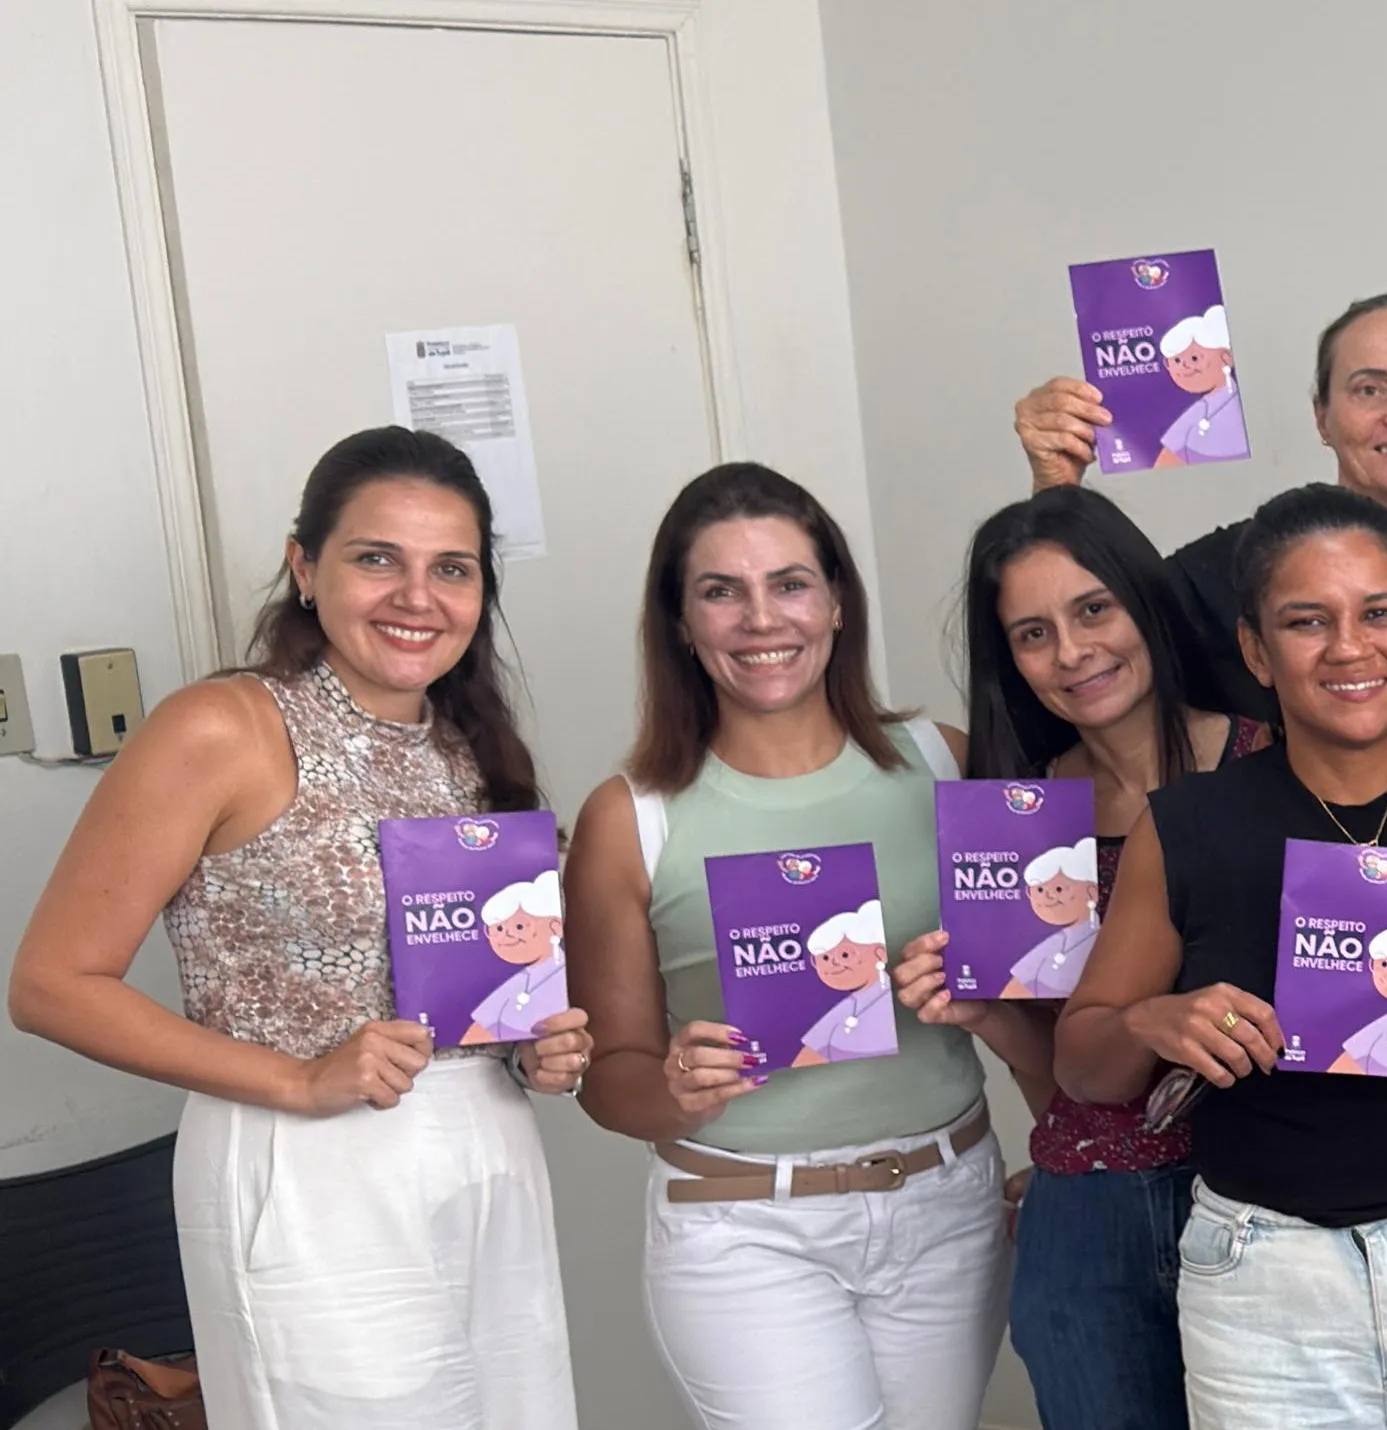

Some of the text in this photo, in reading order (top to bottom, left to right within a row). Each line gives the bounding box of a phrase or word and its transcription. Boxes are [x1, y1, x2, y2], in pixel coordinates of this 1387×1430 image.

[1092, 326, 1154, 342] O RESPEITO
[1096, 338, 1156, 367] NÃO
[1098, 362, 1160, 379] ENVELHECE
[952, 852, 1019, 862] O RESPEITO
[955, 862, 1018, 889] NÃO
[402, 891, 475, 905] O RESPEITO
[954, 889, 1020, 900] ENVELHECE
[406, 904, 475, 933] NÃO
[1295, 917, 1366, 932] O RESPEITO
[407, 930, 479, 946] ENVELHECE
[729, 923, 800, 939] O RESPEITO
[734, 935, 801, 966] NÃO
[1295, 930, 1362, 959] NÃO
[736, 960, 806, 978] ENVELHECE
[1293, 957, 1363, 972] ENVELHECE
